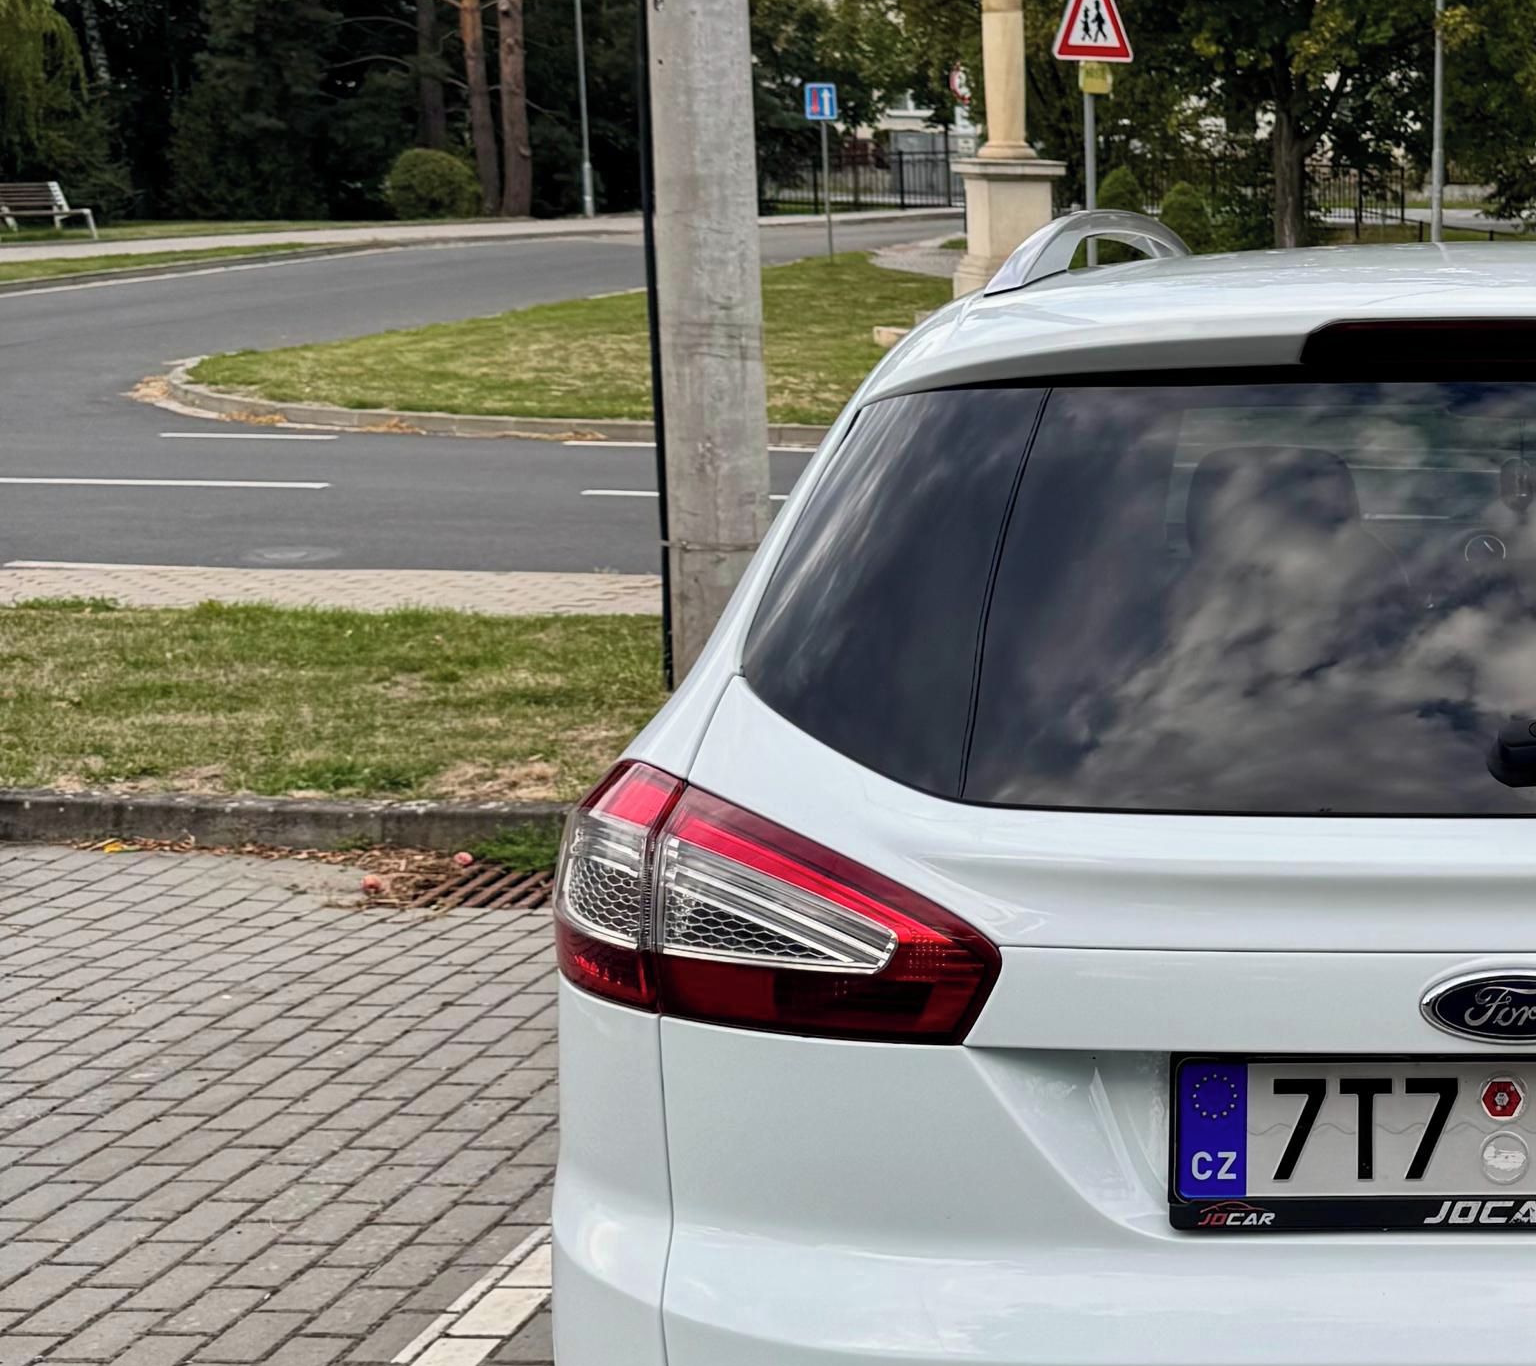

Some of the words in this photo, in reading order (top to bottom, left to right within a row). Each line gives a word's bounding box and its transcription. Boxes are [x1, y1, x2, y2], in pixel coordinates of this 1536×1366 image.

[1273, 1076, 1459, 1180] 7T7
[1191, 1151, 1237, 1180] CZ
[1198, 1212, 1276, 1226] JOCAR
